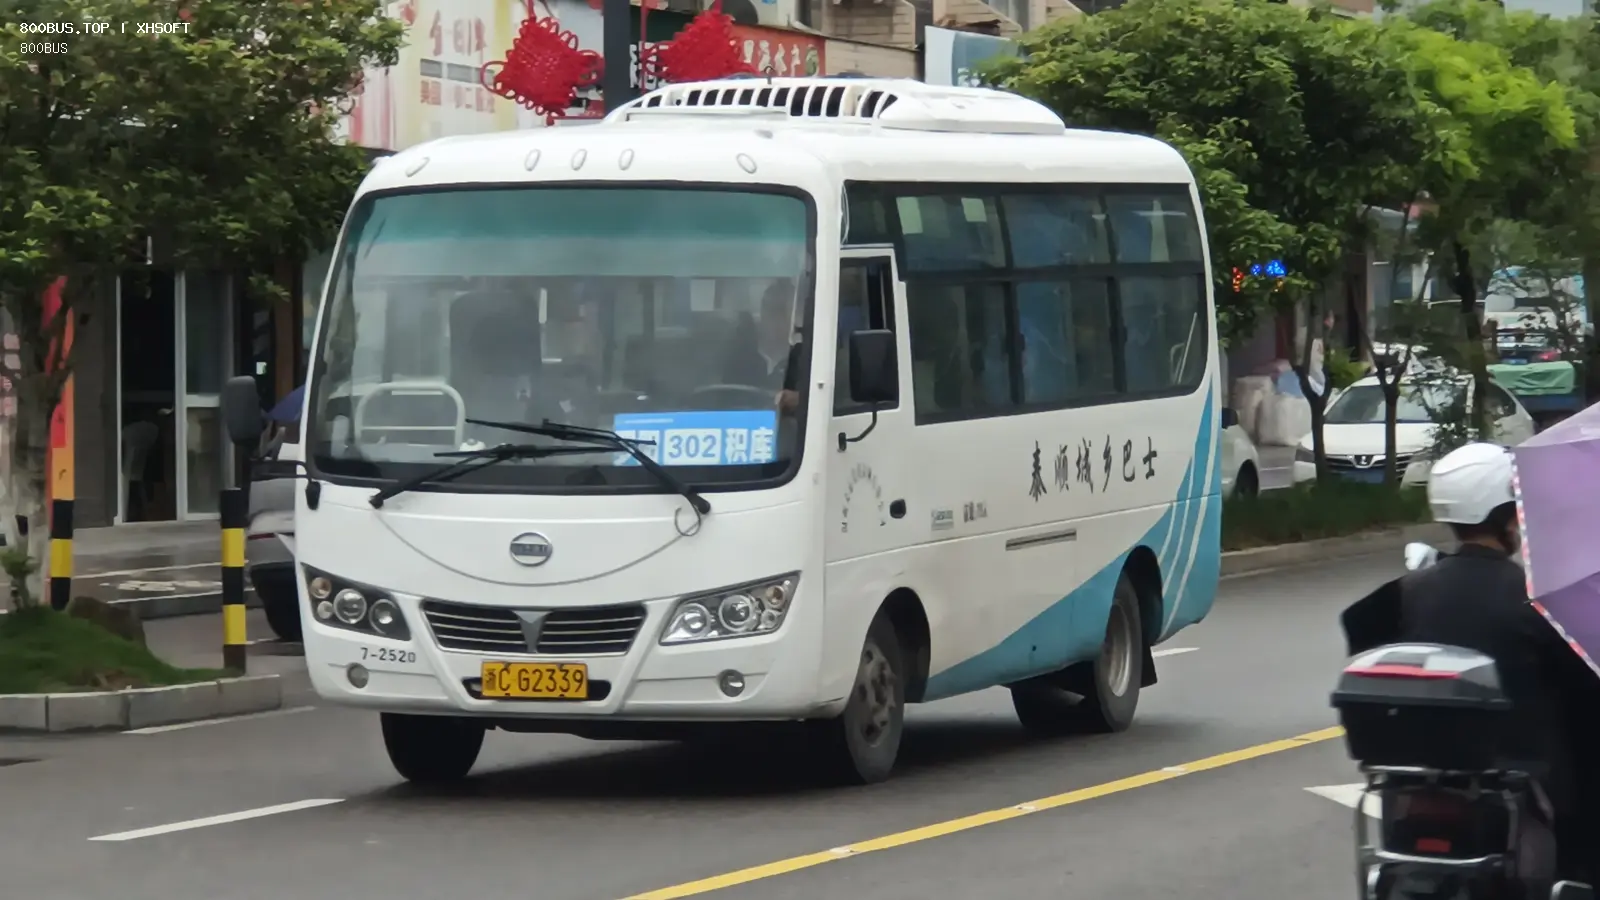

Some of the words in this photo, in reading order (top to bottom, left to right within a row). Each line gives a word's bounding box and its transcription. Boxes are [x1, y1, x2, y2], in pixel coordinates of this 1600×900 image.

[668, 434, 718, 458] 302
[1029, 434, 1157, 502] 泰顺城乡巴士
[360, 647, 416, 663] 7-2520
